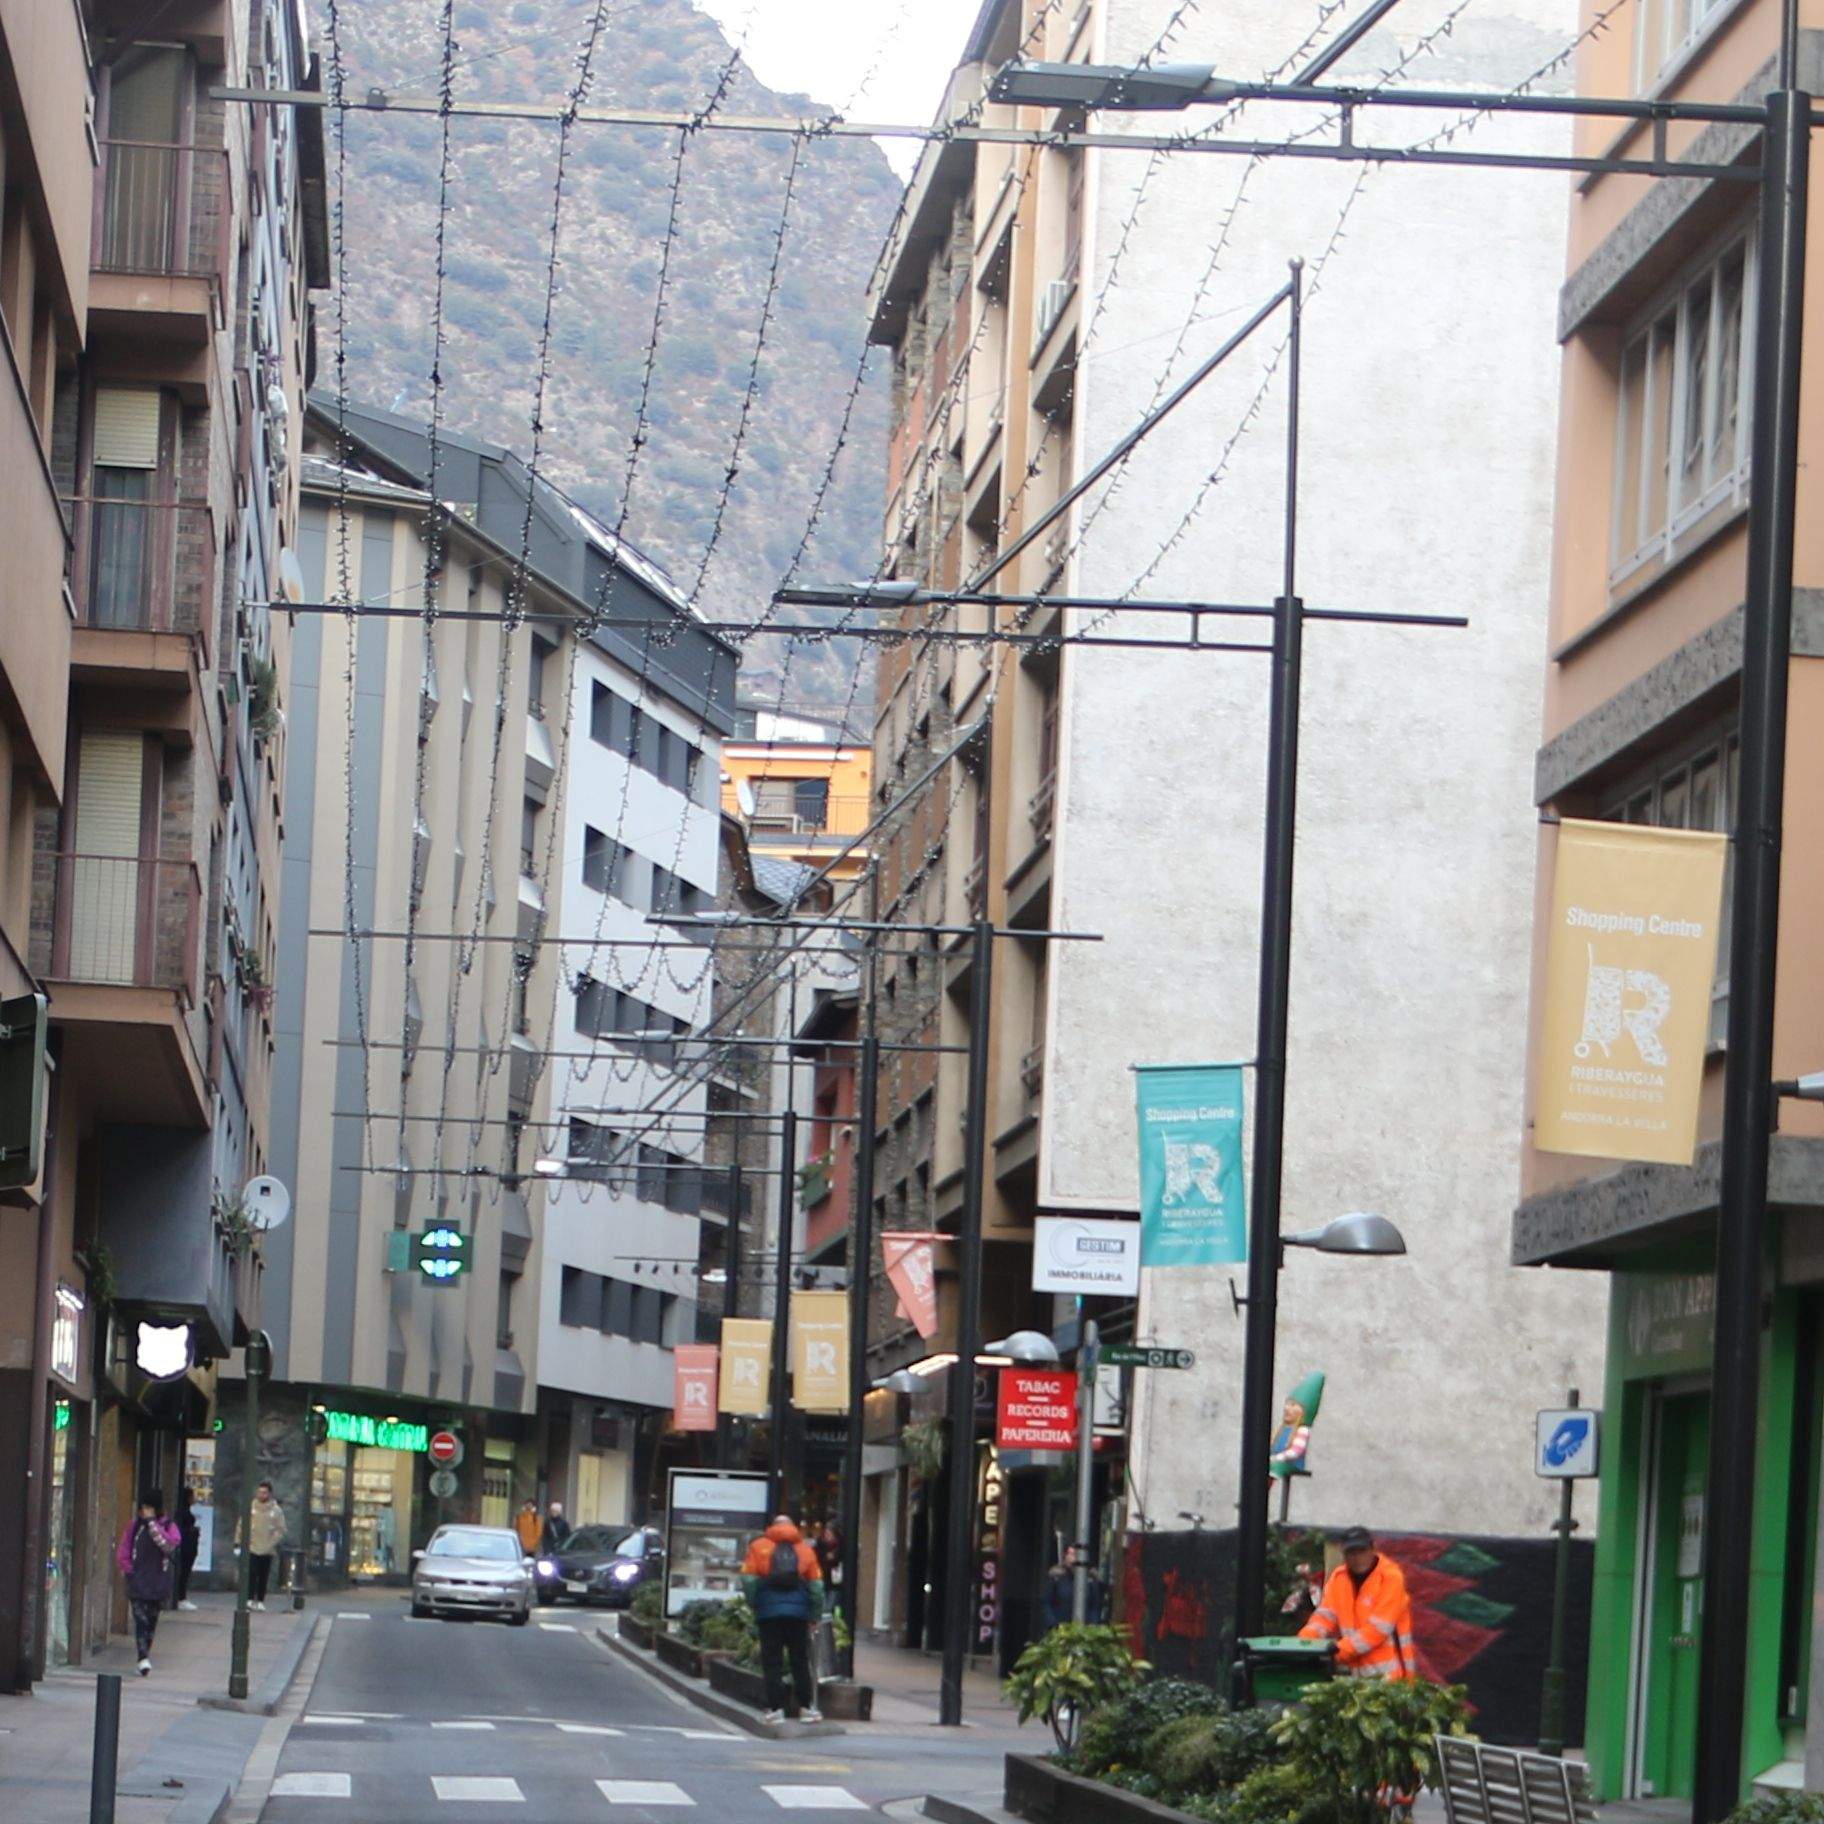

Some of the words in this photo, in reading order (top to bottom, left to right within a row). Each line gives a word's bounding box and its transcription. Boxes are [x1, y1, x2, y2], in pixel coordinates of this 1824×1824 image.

[1565, 905, 1645, 935] Shopping
[1647, 913, 1704, 938] Centre
[1570, 1064, 1665, 1087] RIBERAYGUA
[1015, 1380, 1061, 1395] TABAC
[1007, 1403, 1069, 1419] RECORDS
[1001, 1427, 1072, 1444] PAPERERIA
[979, 1561, 997, 1643] SHOP
